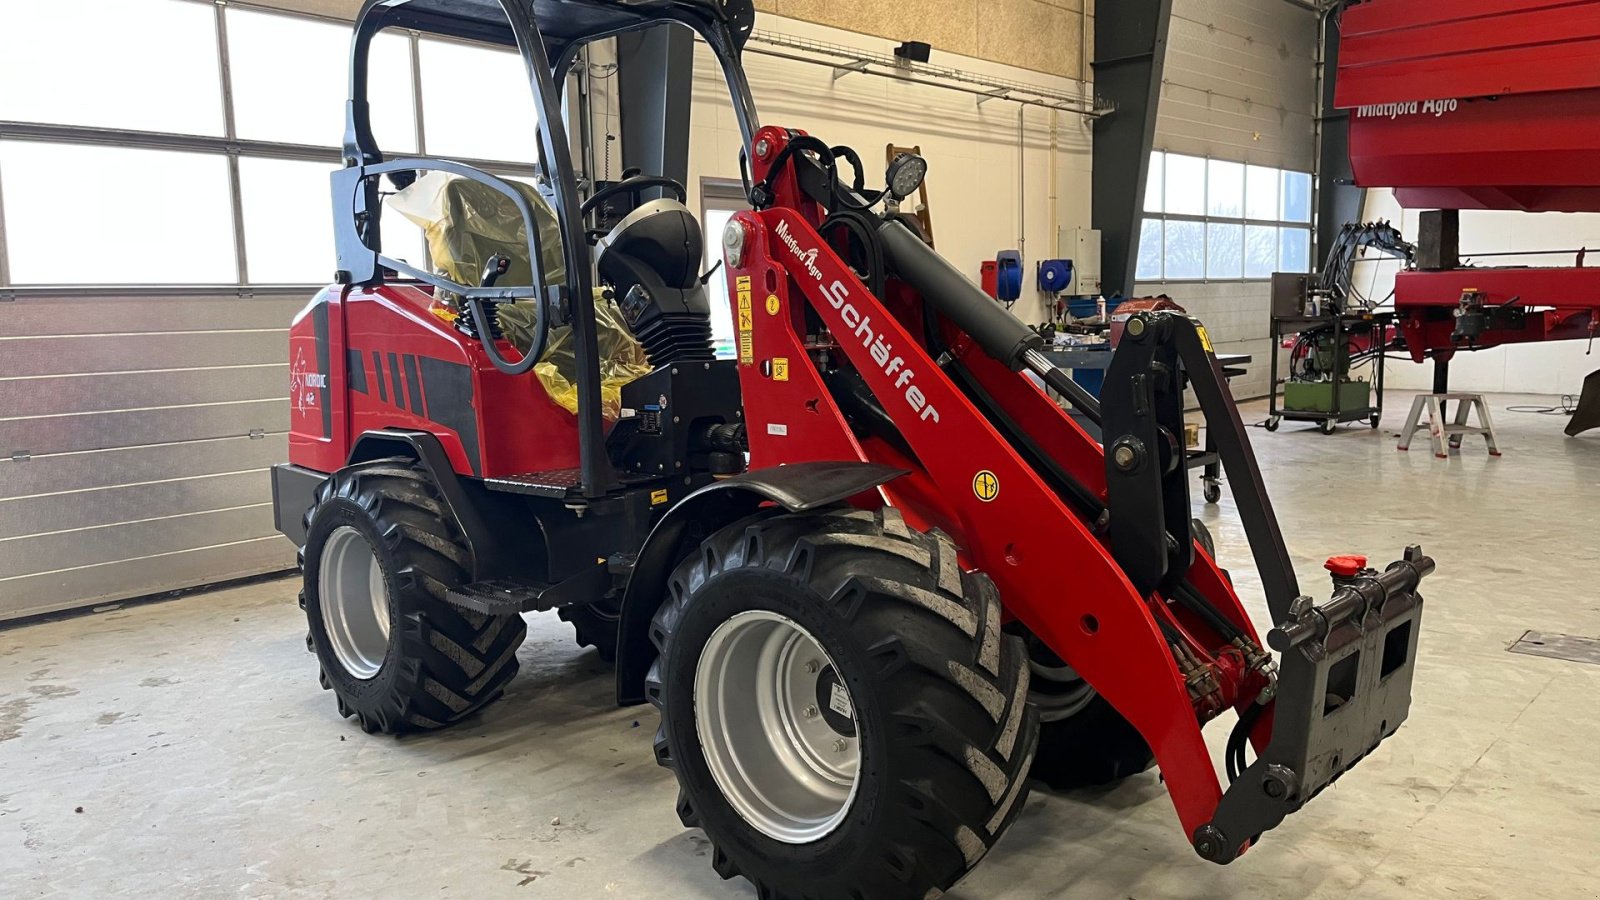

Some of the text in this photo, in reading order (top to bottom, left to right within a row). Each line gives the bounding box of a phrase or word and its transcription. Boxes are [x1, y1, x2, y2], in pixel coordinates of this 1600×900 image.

[1422, 98, 1458, 117] Agro
[775, 219, 823, 281] Midtfjord Agro
[818, 280, 940, 424] Schäffer
[305, 372, 326, 389] NORDIC
[306, 392, 315, 406] 42
